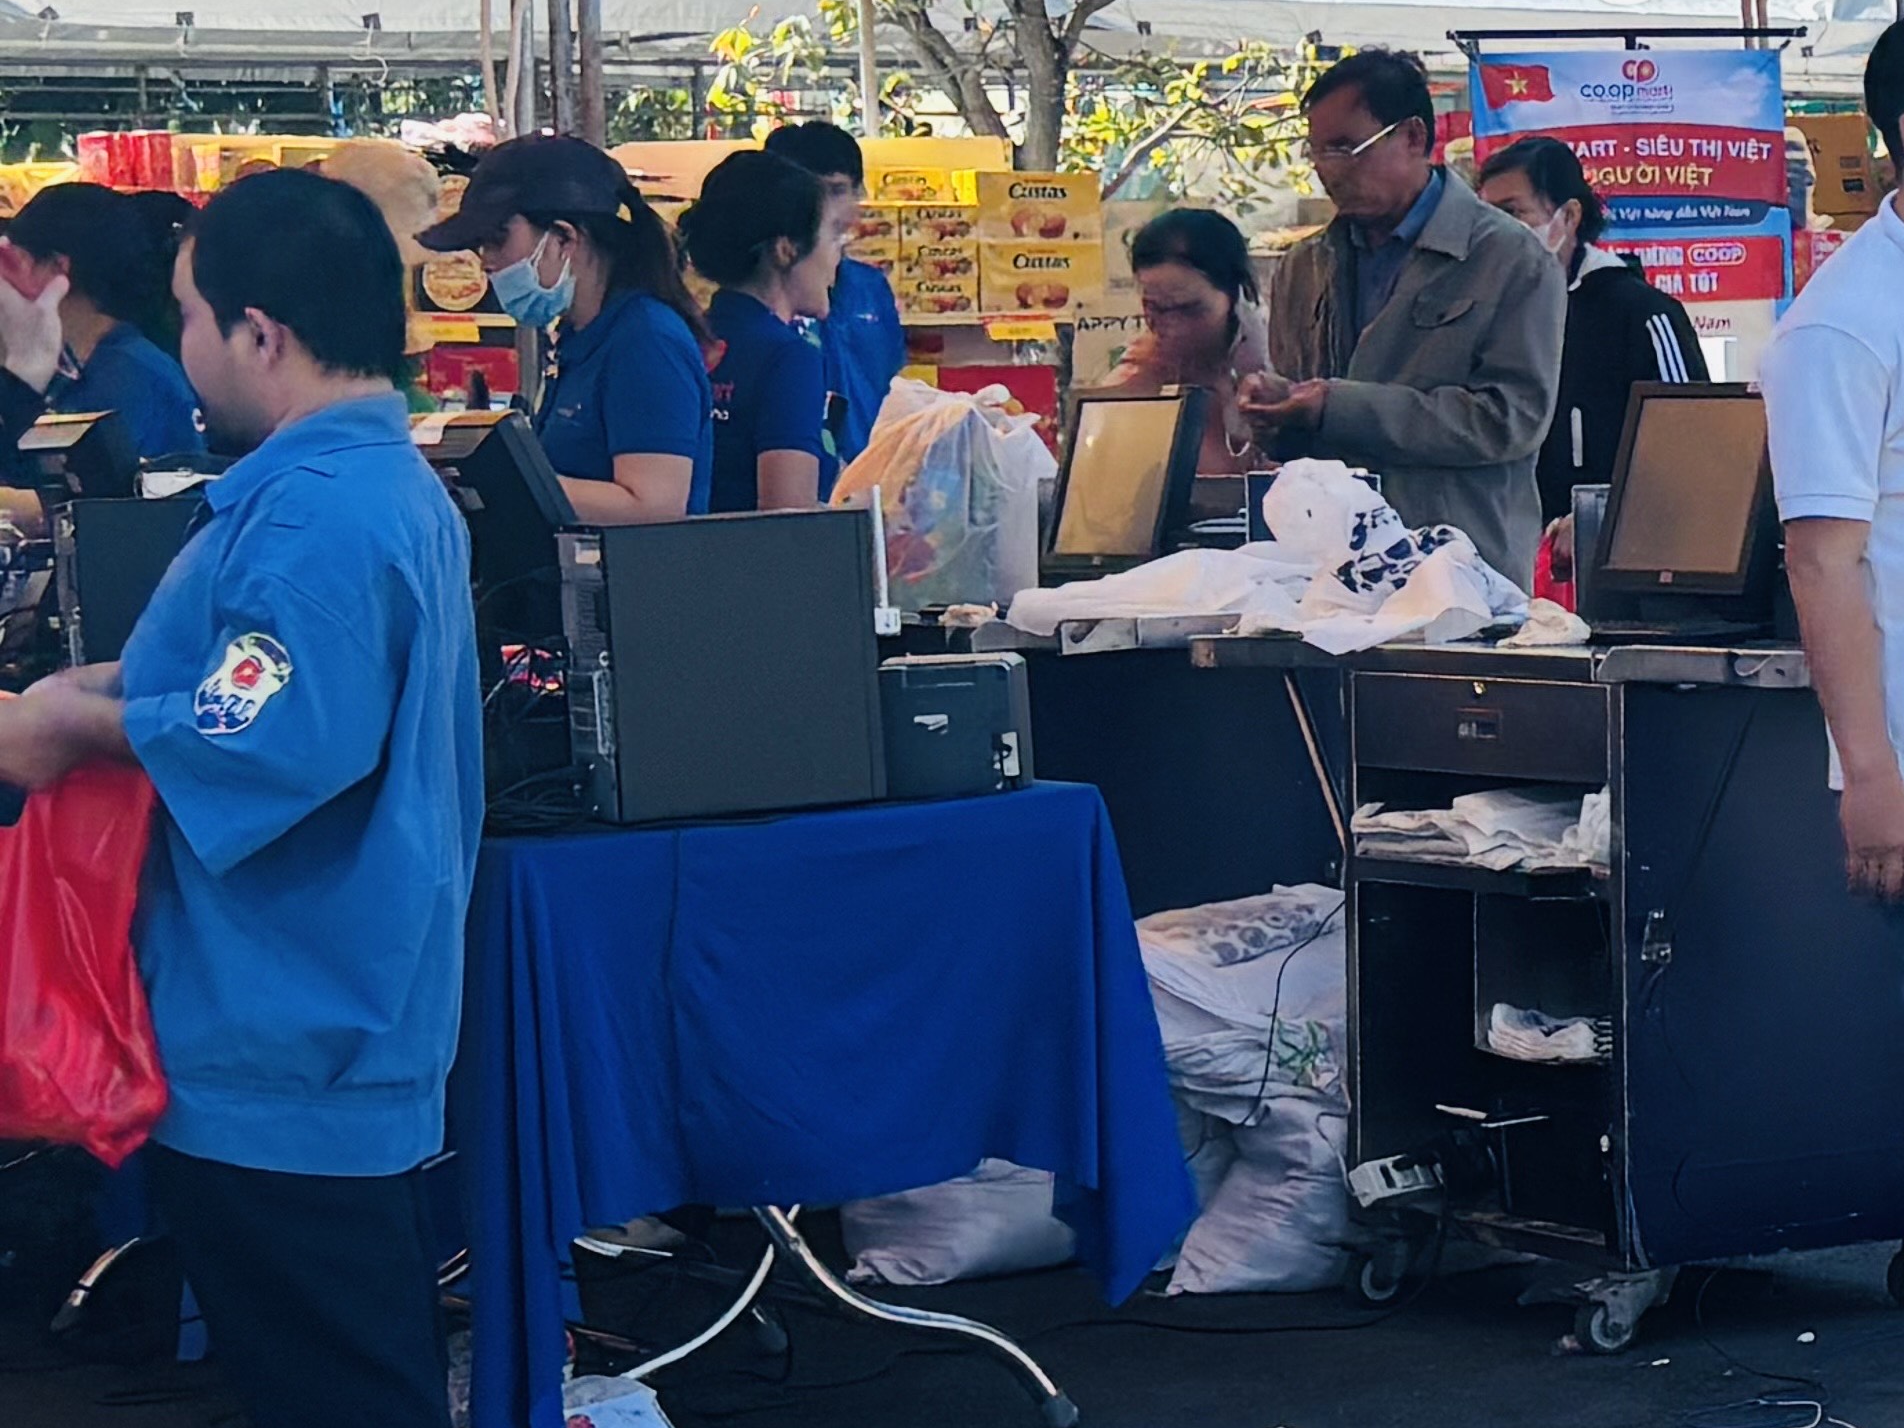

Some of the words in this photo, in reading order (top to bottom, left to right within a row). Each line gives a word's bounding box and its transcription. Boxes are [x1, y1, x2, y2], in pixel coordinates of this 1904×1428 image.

[1635, 133, 1685, 157] SIÊU
[1688, 138, 1723, 162] THỊ
[1726, 137, 1772, 164] VIỆT
[1664, 162, 1714, 190] VIỆT
